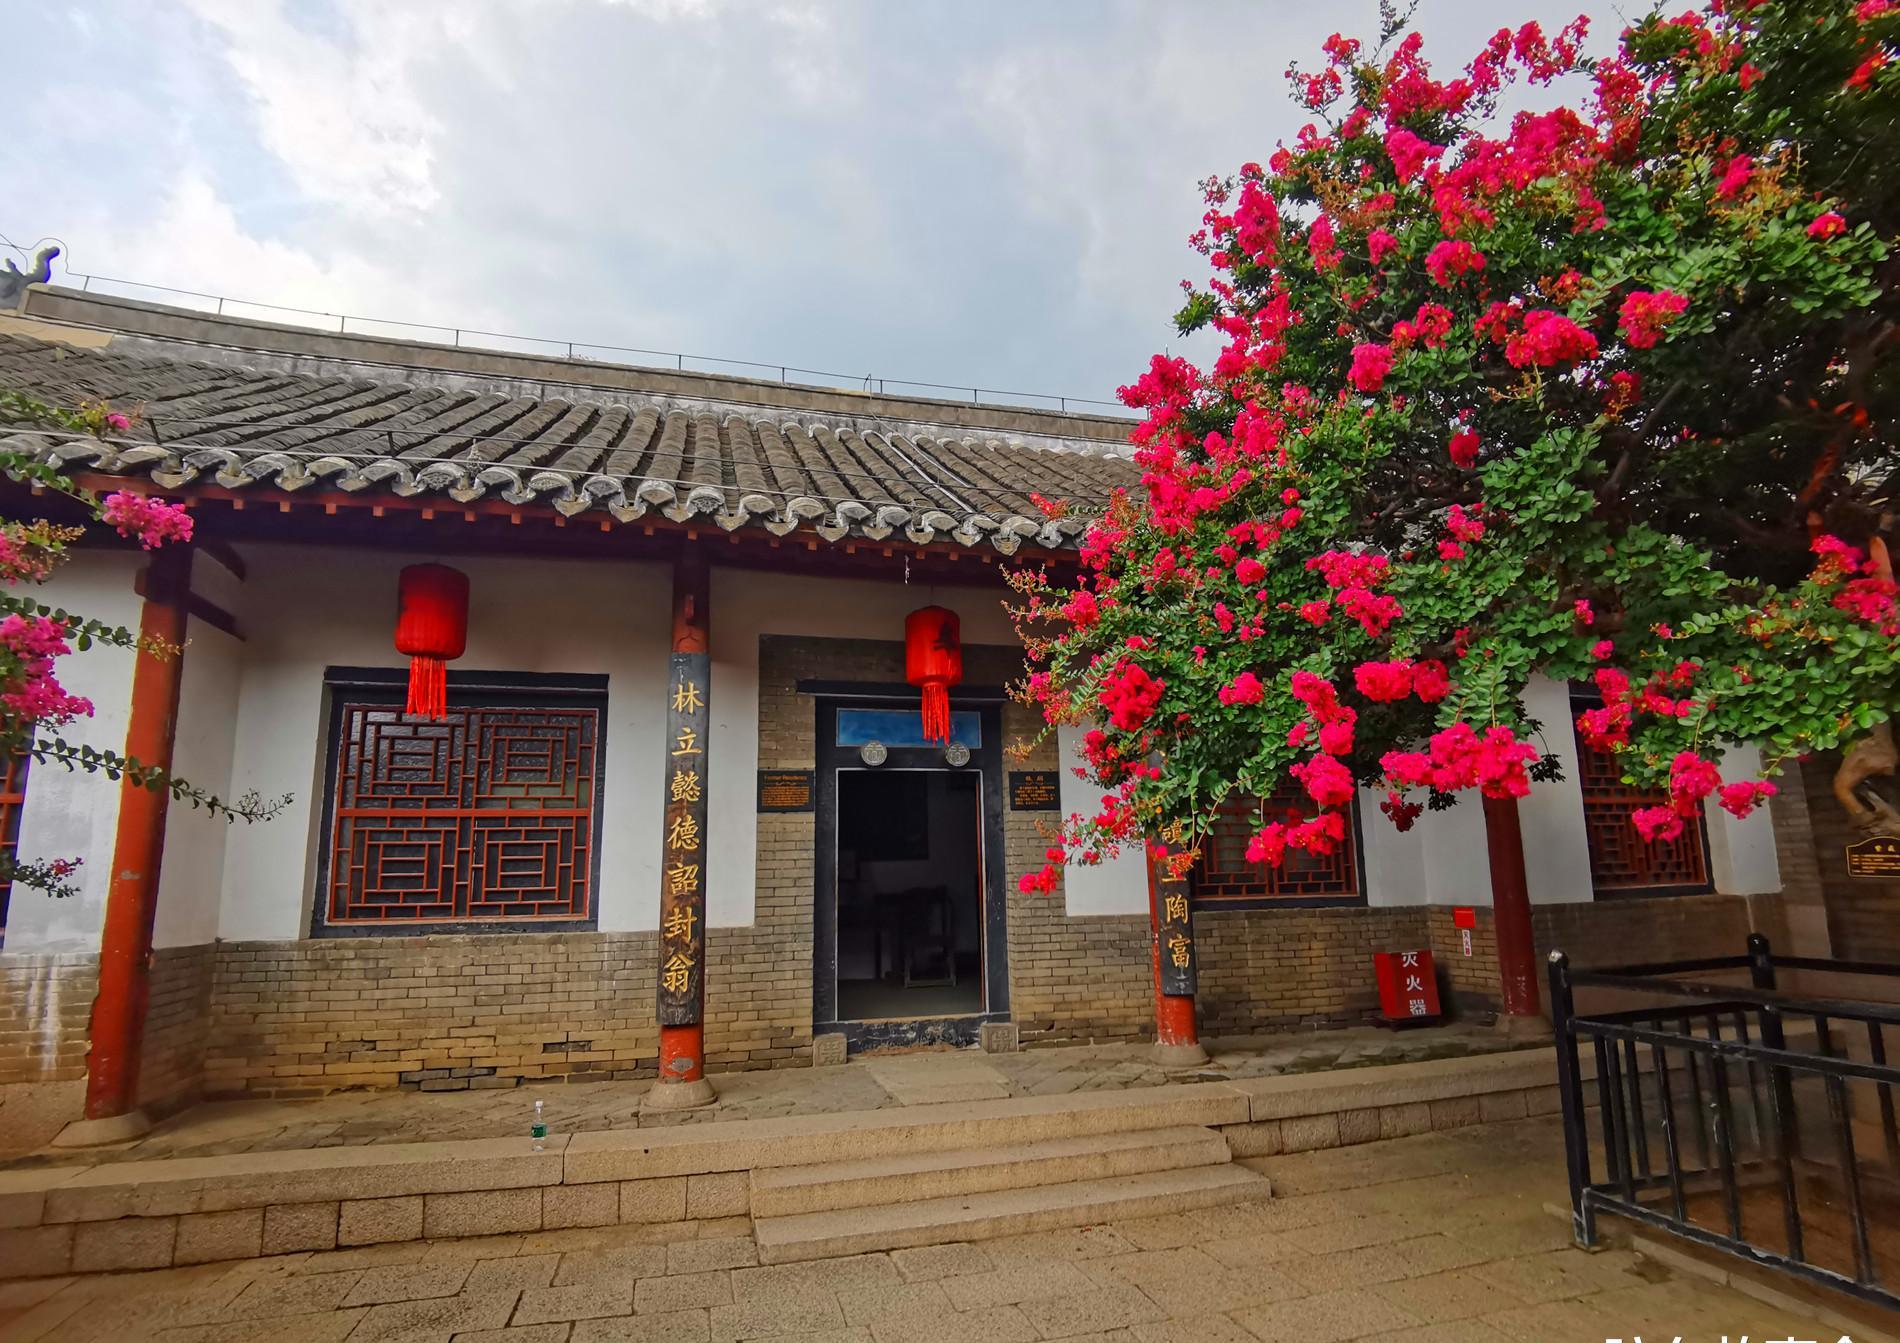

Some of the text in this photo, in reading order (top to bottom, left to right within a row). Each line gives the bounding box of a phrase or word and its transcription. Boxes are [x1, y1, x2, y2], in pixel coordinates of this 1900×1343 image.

[662, 681, 704, 992] 林立懿德詔封翁
[1401, 951, 1427, 1015] 灭火器
